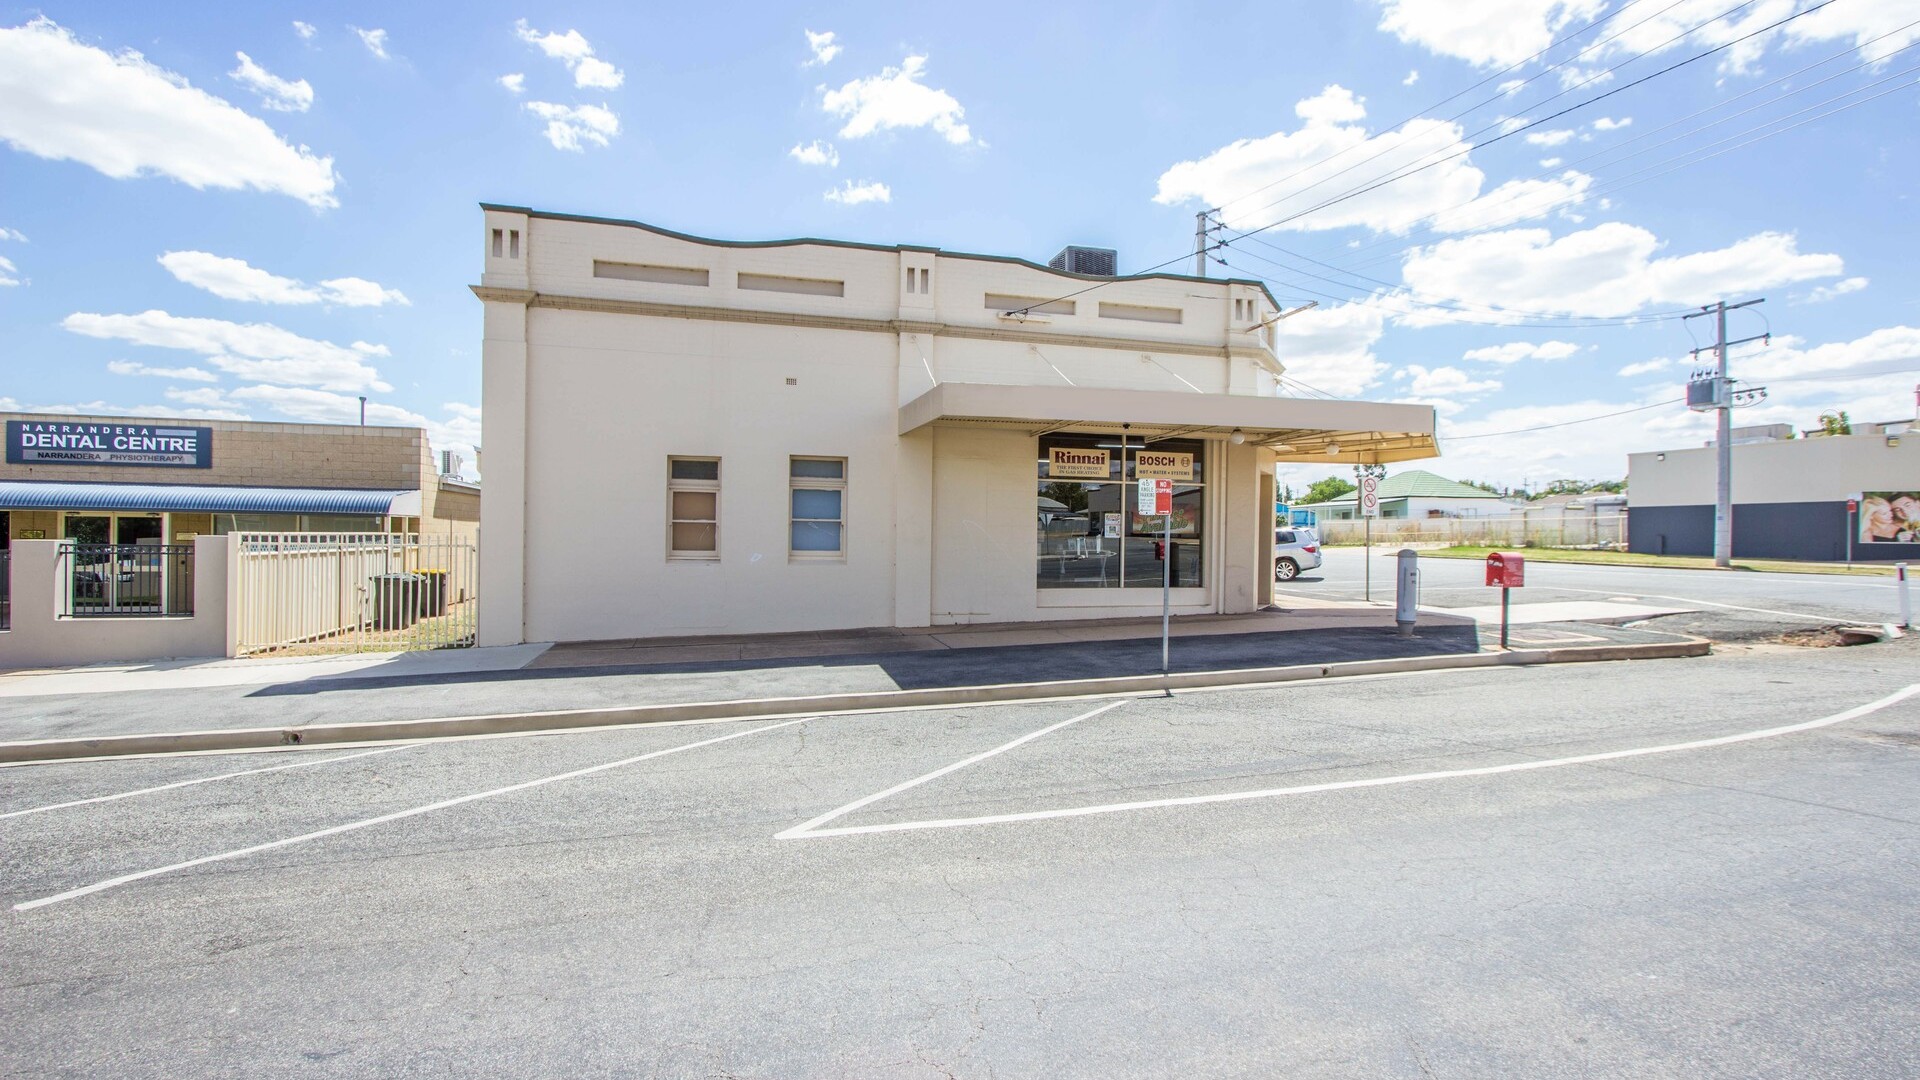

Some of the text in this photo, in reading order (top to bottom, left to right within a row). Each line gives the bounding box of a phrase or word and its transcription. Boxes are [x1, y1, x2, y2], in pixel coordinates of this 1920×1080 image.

[22, 424, 149, 435] NARRANDERA
[22, 433, 197, 452] DENTAL CENTRE
[37, 452, 183, 462] NARRANDERA PHYSIOTHERAPY
[1054, 451, 1106, 465] Rinnai
[1139, 456, 1176, 466] BOSCH
